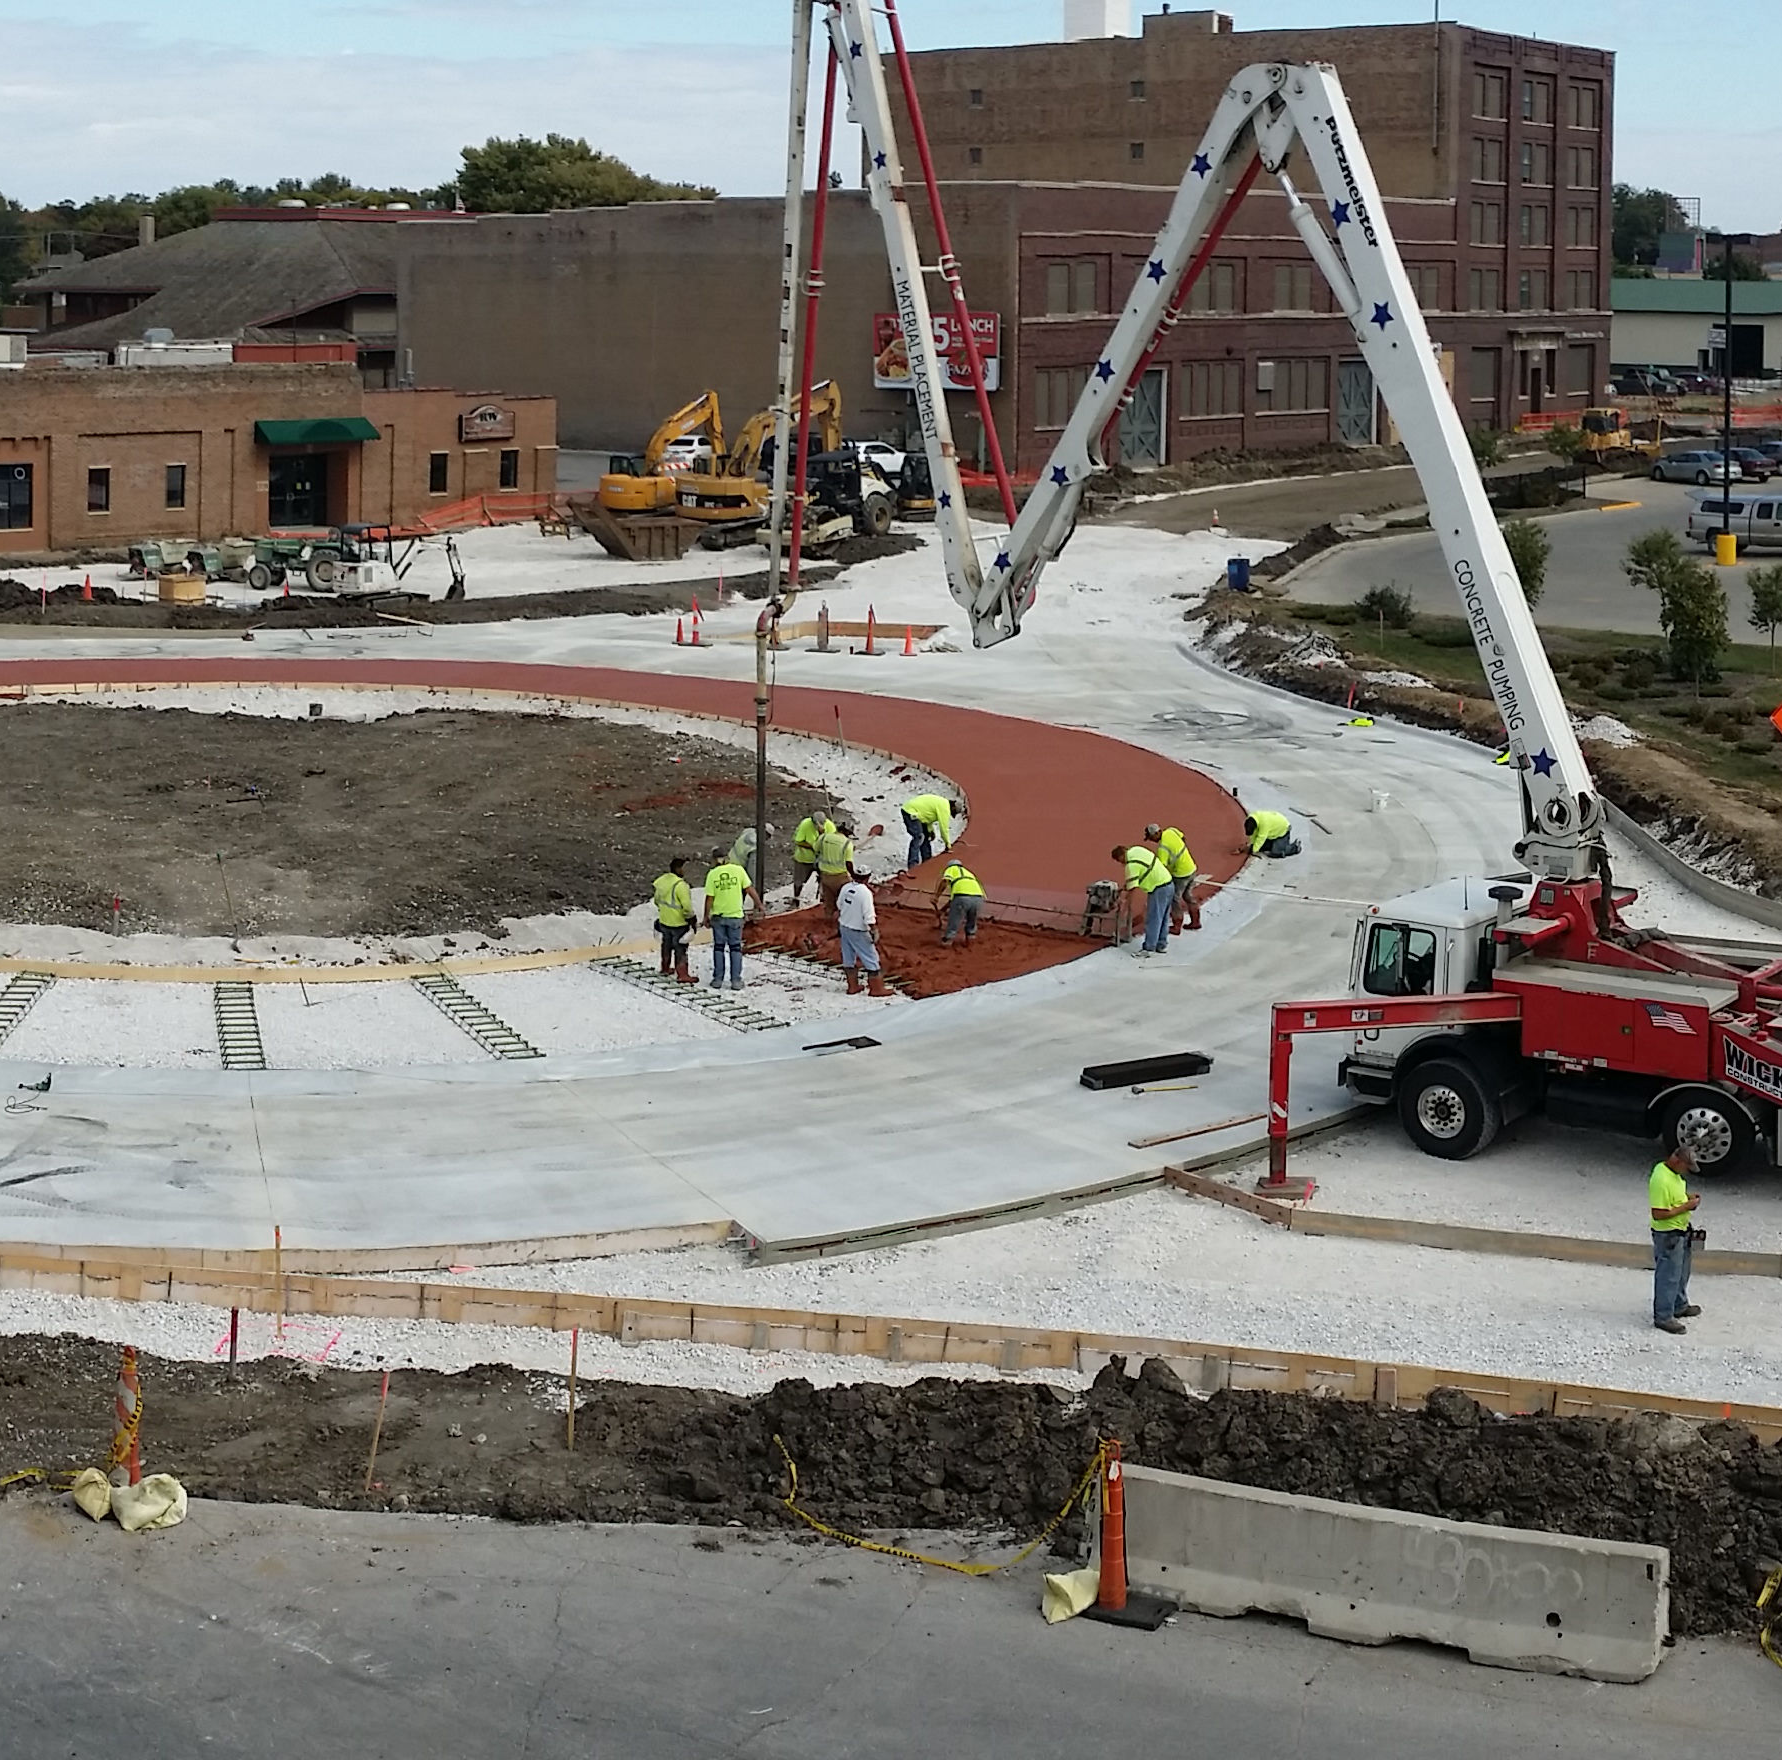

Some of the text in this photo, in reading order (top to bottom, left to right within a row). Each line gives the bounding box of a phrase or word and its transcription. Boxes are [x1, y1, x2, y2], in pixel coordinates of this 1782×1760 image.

[897, 280, 921, 352] MATERIAL
[910, 354, 938, 439] PLACEMENT
[951, 319, 994, 333] LNCH
[682, 494, 698, 508] CAT
[1454, 559, 1525, 731] CONCRETE PUMPING
